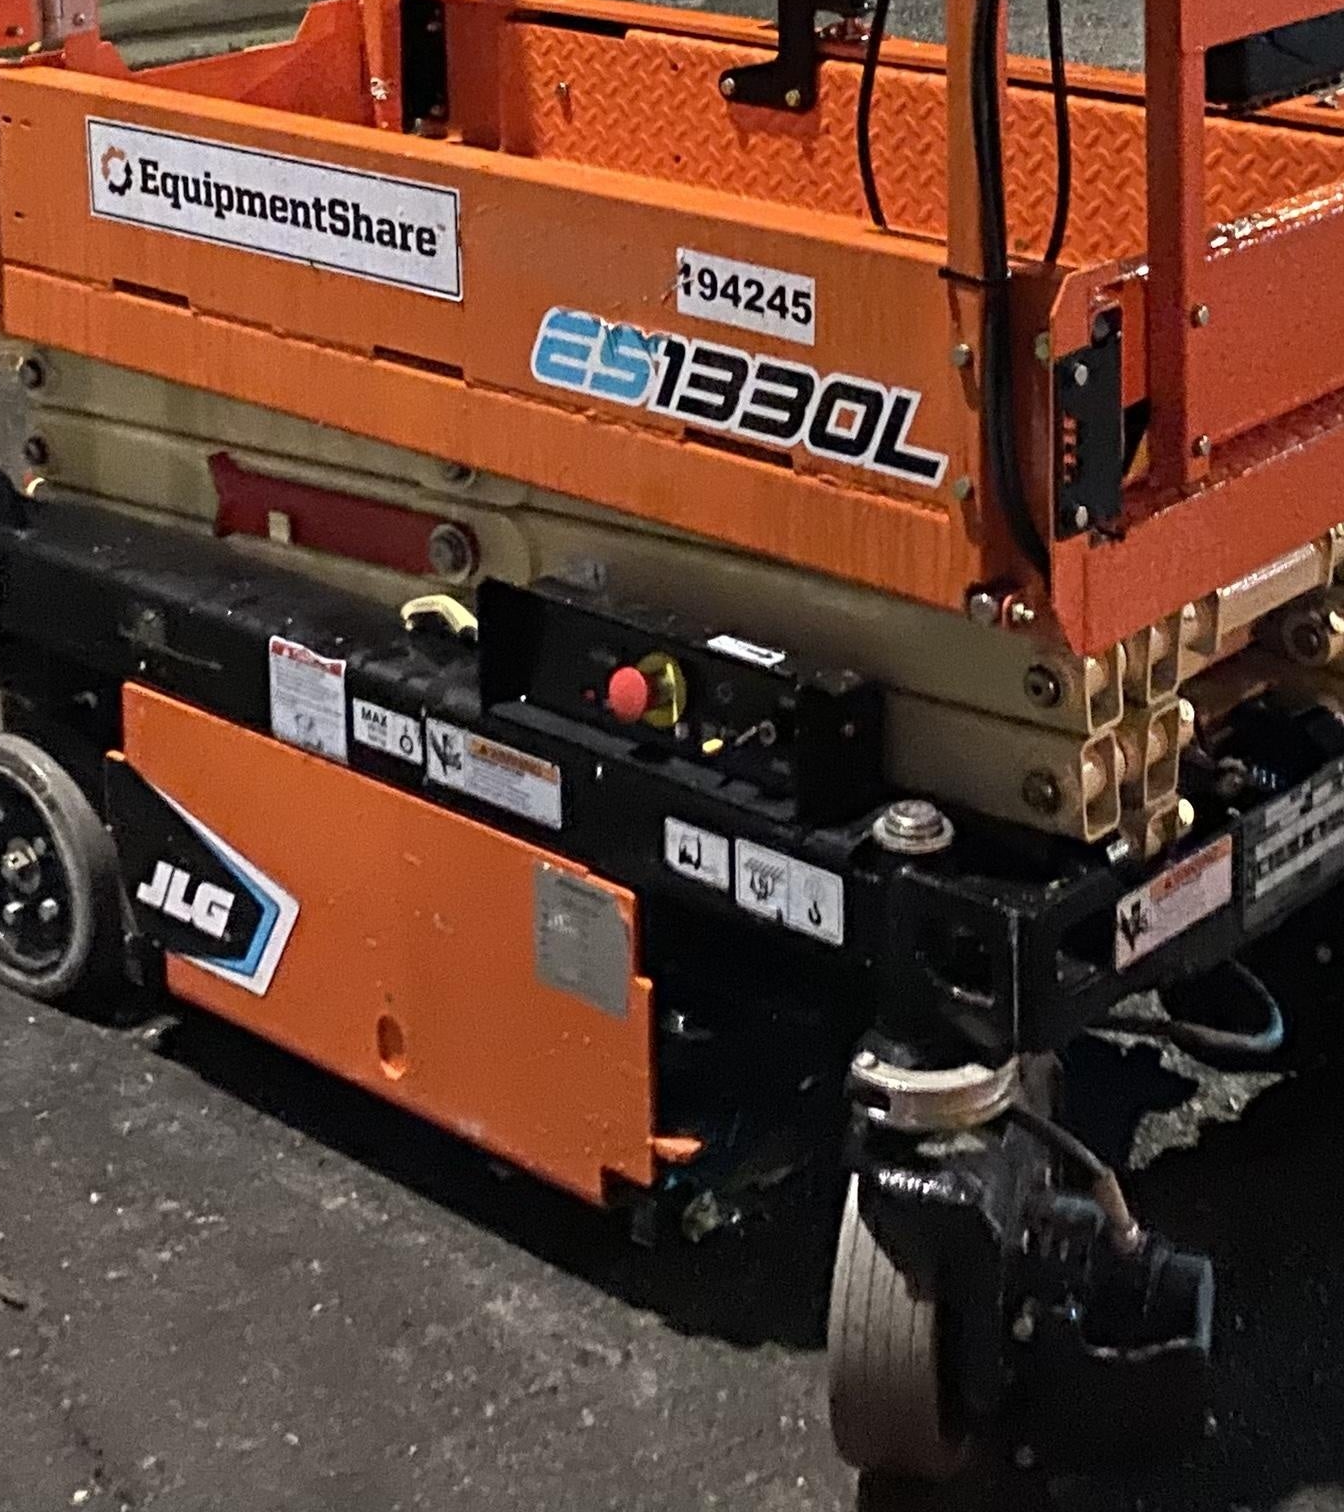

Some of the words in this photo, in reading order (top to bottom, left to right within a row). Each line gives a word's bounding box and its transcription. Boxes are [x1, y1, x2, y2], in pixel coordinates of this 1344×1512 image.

[139, 157, 438, 258] EquipmentShare
[678, 263, 813, 326] 194245
[533, 310, 943, 481] ES1330L
[361, 706, 388, 729] MAX
[136, 860, 235, 938] JLG
